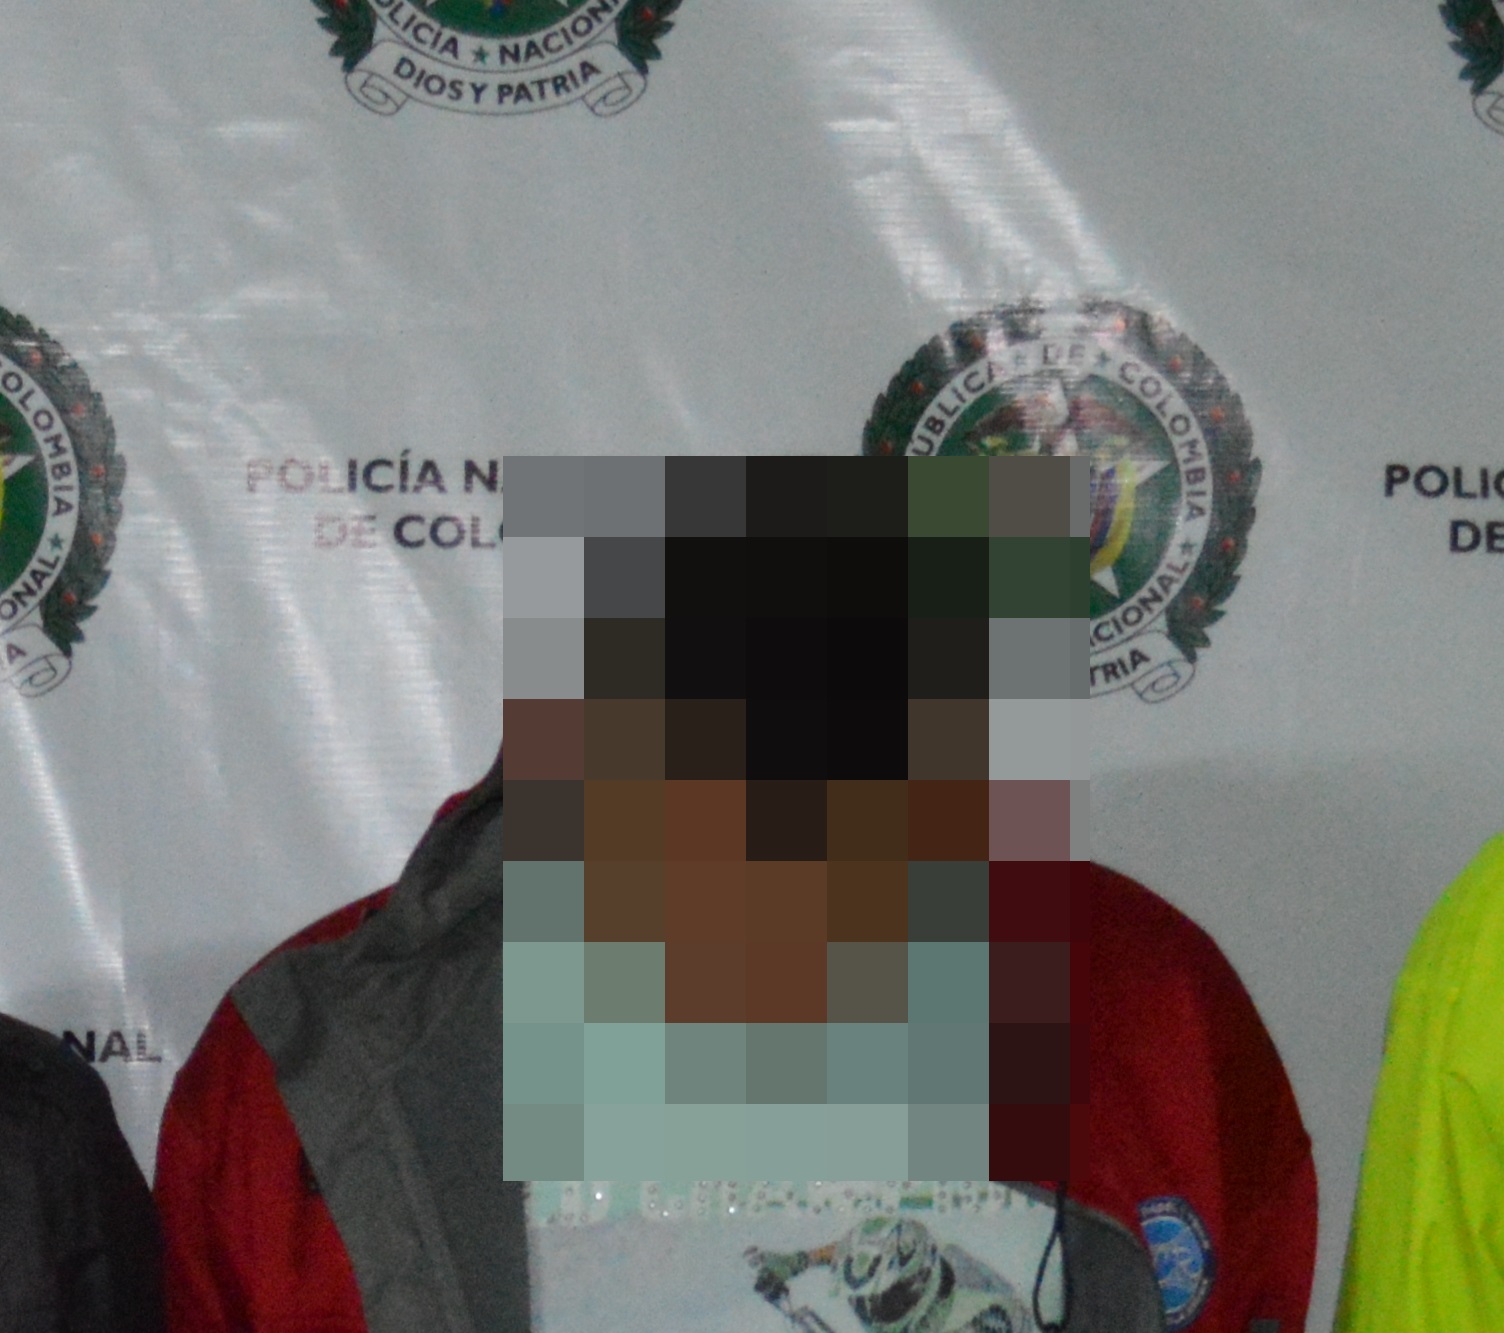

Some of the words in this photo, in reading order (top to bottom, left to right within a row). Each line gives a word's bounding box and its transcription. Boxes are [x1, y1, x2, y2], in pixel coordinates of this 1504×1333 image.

[393, 56, 464, 100] DIOS
[496, 60, 601, 105] PATRIA
[1041, 342, 1086, 366] DE
[1118, 362, 1206, 523] COLOMBIA
[246, 448, 448, 494] POLICÍA
[313, 513, 378, 549] DE
